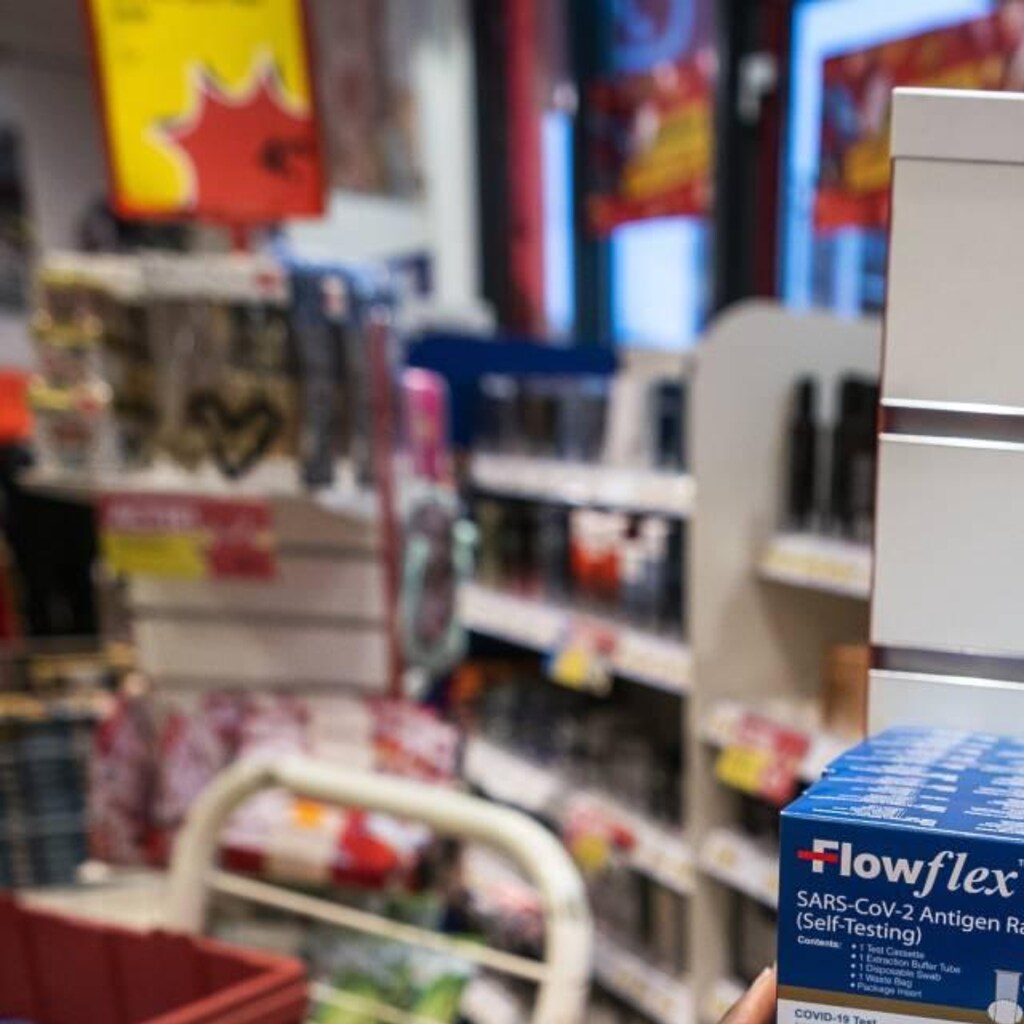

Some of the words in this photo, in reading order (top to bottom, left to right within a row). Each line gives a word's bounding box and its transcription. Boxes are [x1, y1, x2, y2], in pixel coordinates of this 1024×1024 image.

[798, 839, 1018, 898] Flowflex
[797, 891, 914, 920] SARS-CoV-2
[919, 906, 1000, 932] Antigen
[796, 912, 921, 945] (Self-Testing)
[797, 936, 842, 948] Contents:
[795, 1008, 849, 1024] COVID-19
